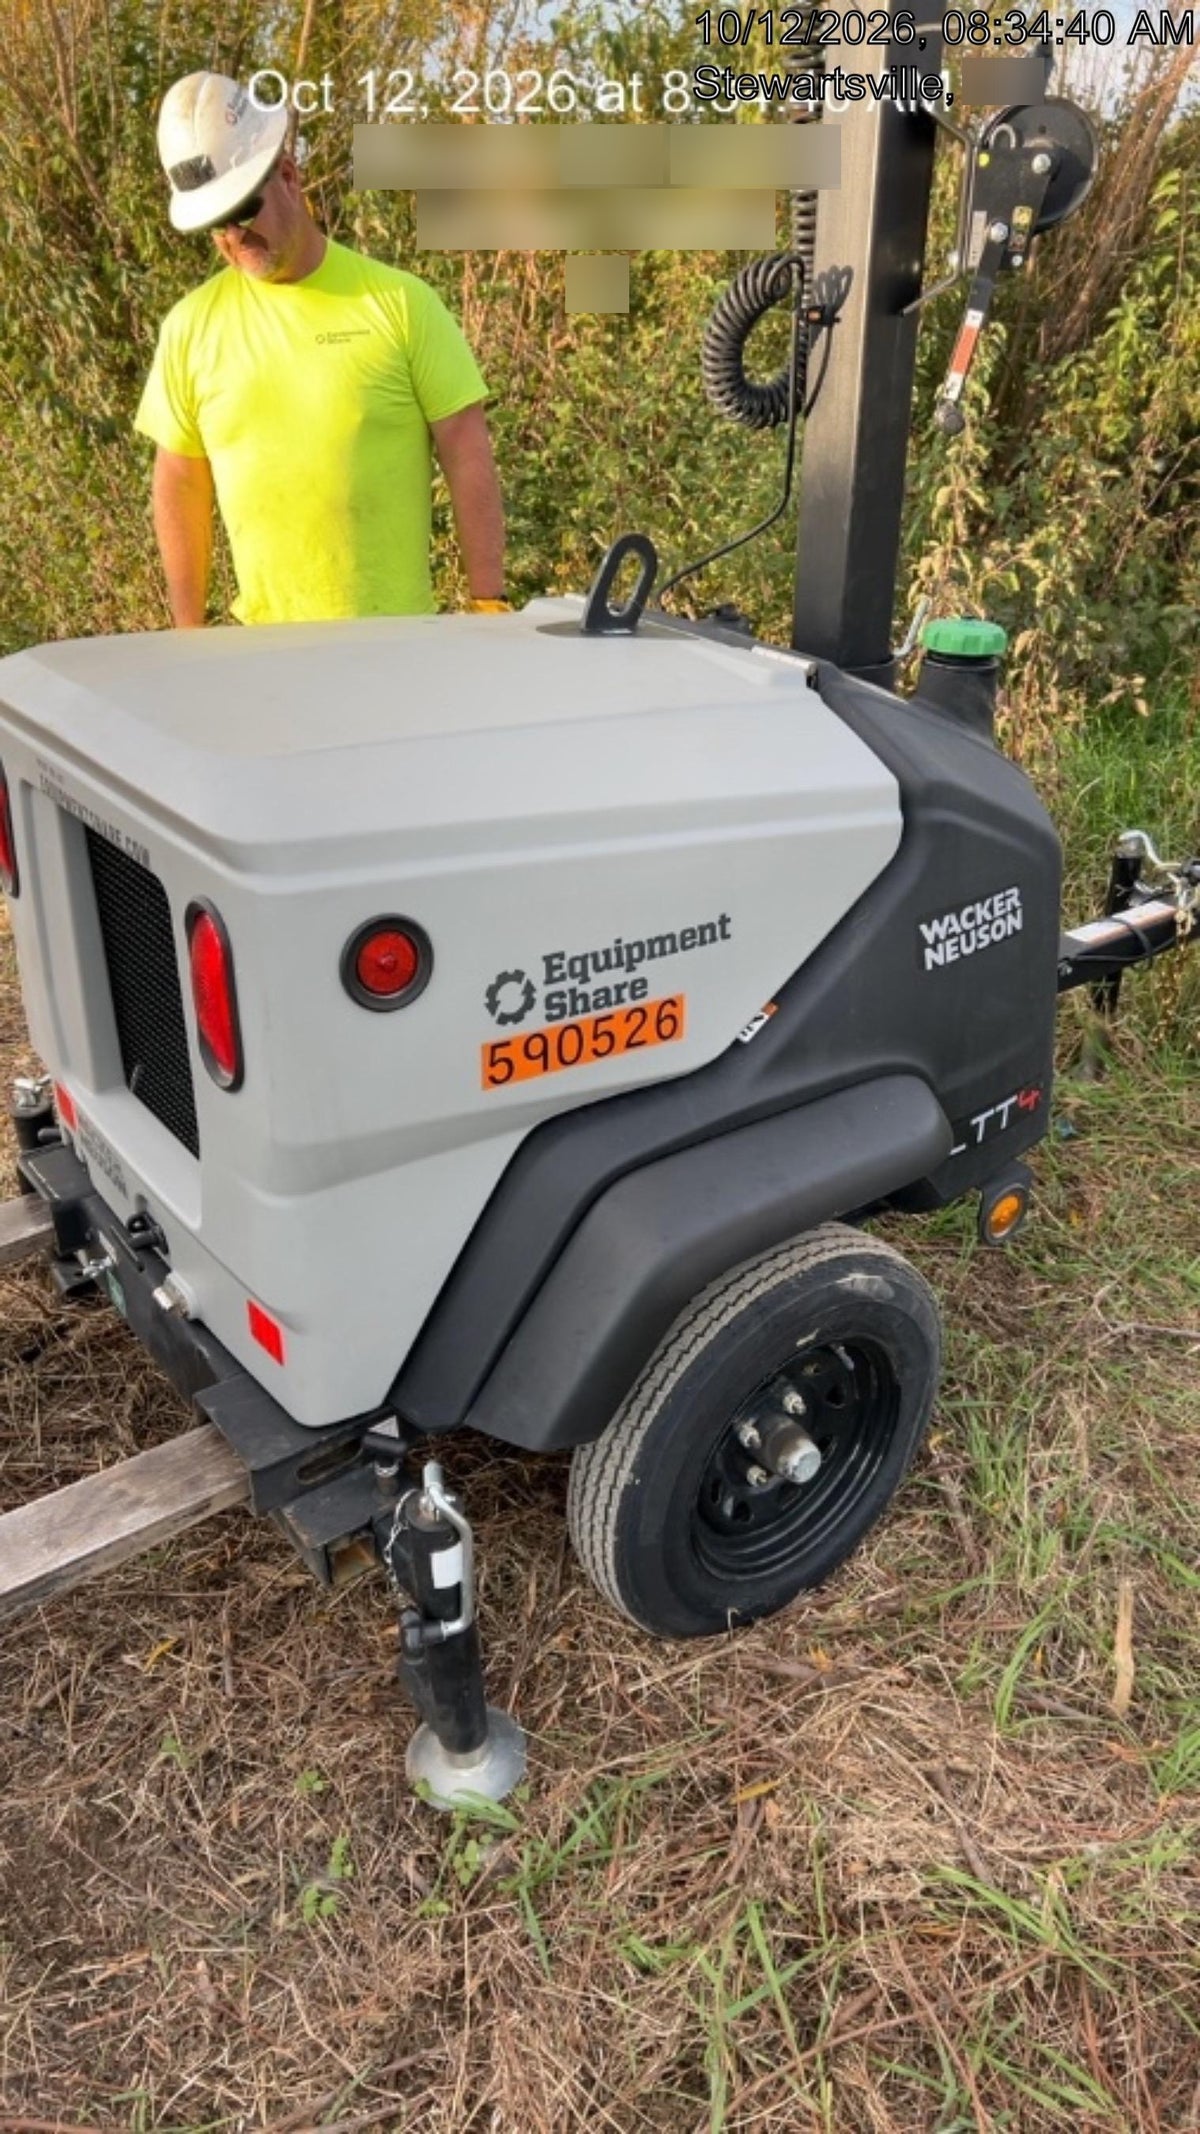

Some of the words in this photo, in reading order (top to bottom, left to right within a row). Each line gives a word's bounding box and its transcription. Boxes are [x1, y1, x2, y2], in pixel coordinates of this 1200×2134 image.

[919, 886, 1022, 945] WACKER
[924, 909, 1023, 970] NEUSON
[542, 913, 732, 985] Equipment
[544, 976, 649, 1023] Share
[488, 998, 679, 1086] 590526
[950, 1088, 1041, 1155] TT4
